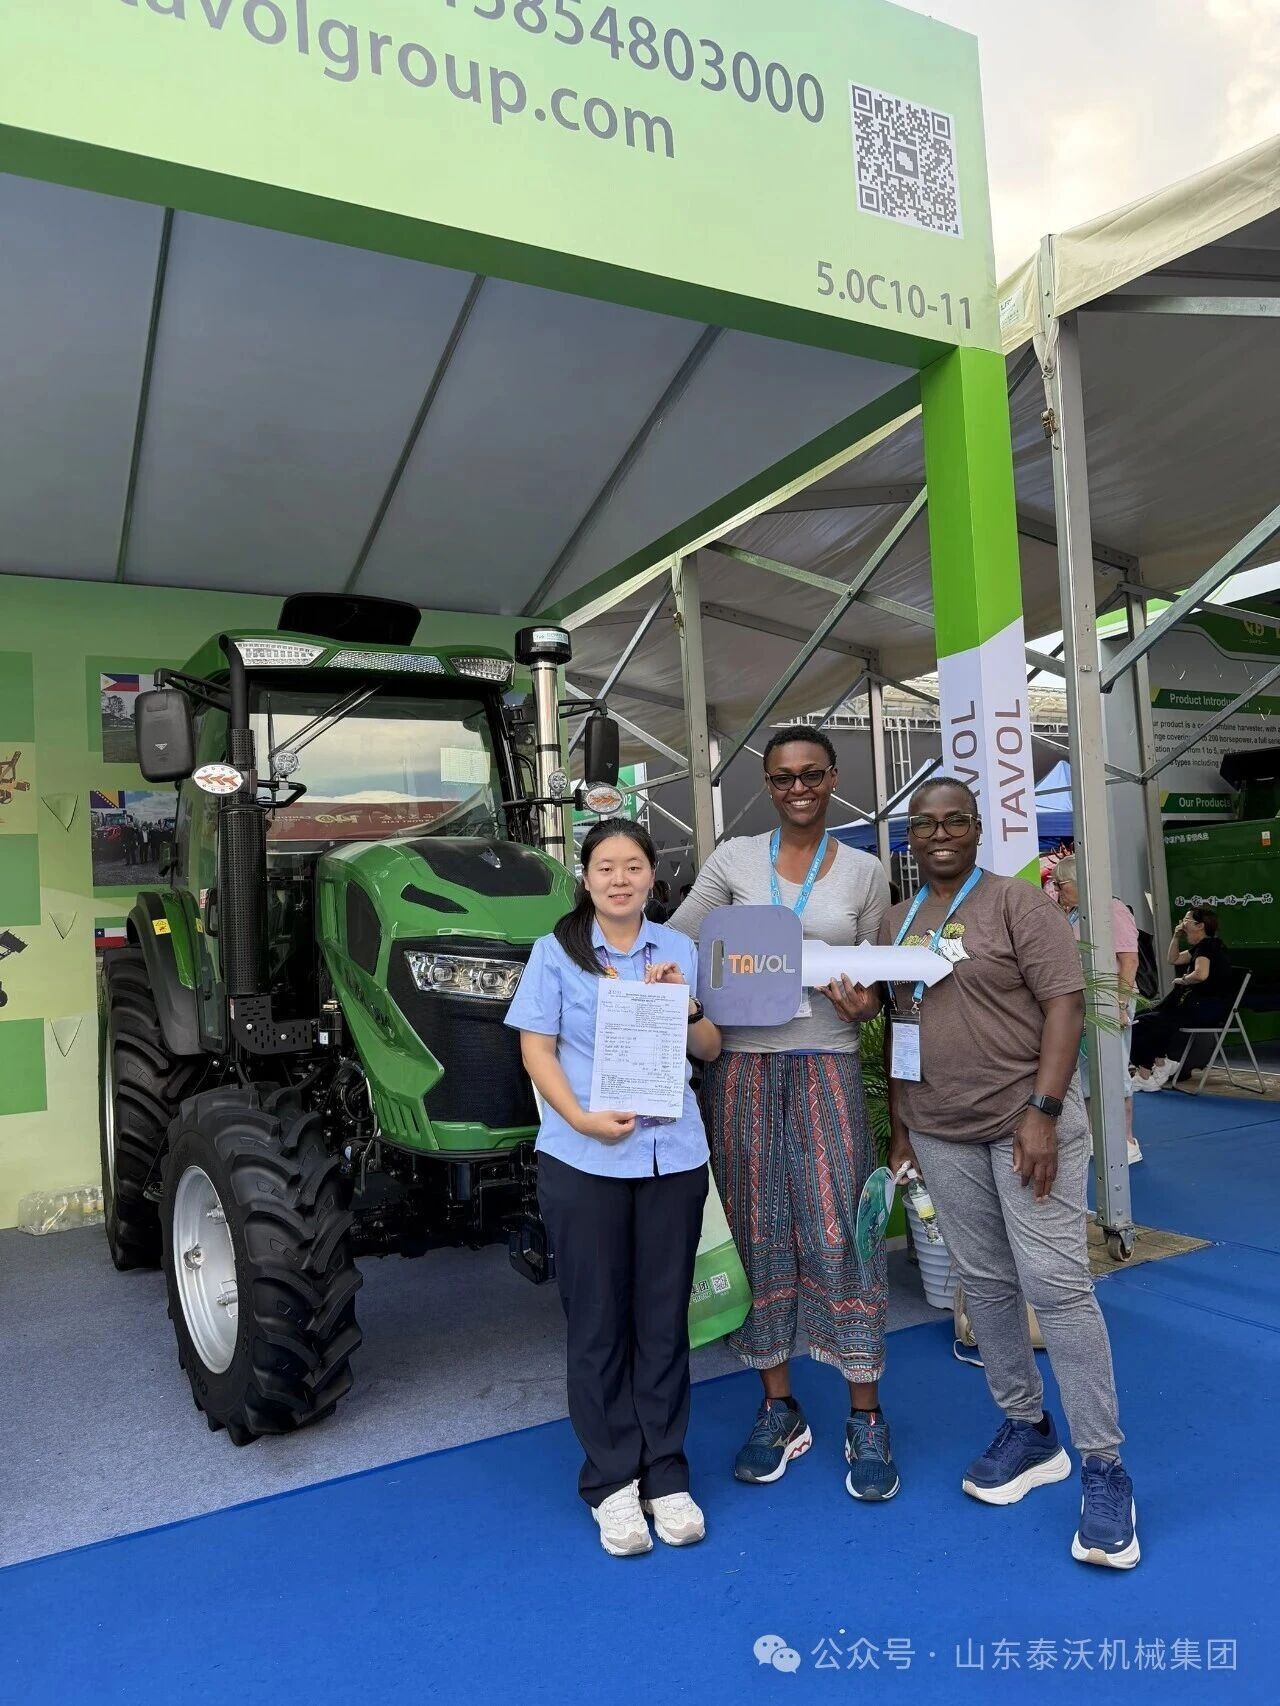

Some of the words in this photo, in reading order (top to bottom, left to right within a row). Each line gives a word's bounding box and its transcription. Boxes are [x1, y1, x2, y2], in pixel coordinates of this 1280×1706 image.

[121, 0, 676, 159] volgroup.com
[446, 0, 825, 124] 854803000
[817, 260, 972, 330] 5.0C10-11
[1169, 693, 1202, 706] Product
[950, 700, 983, 799] VOL
[994, 698, 1030, 843] TAVOL
[1178, 797, 1195, 808] Our
[727, 953, 796, 975] TAVOL
